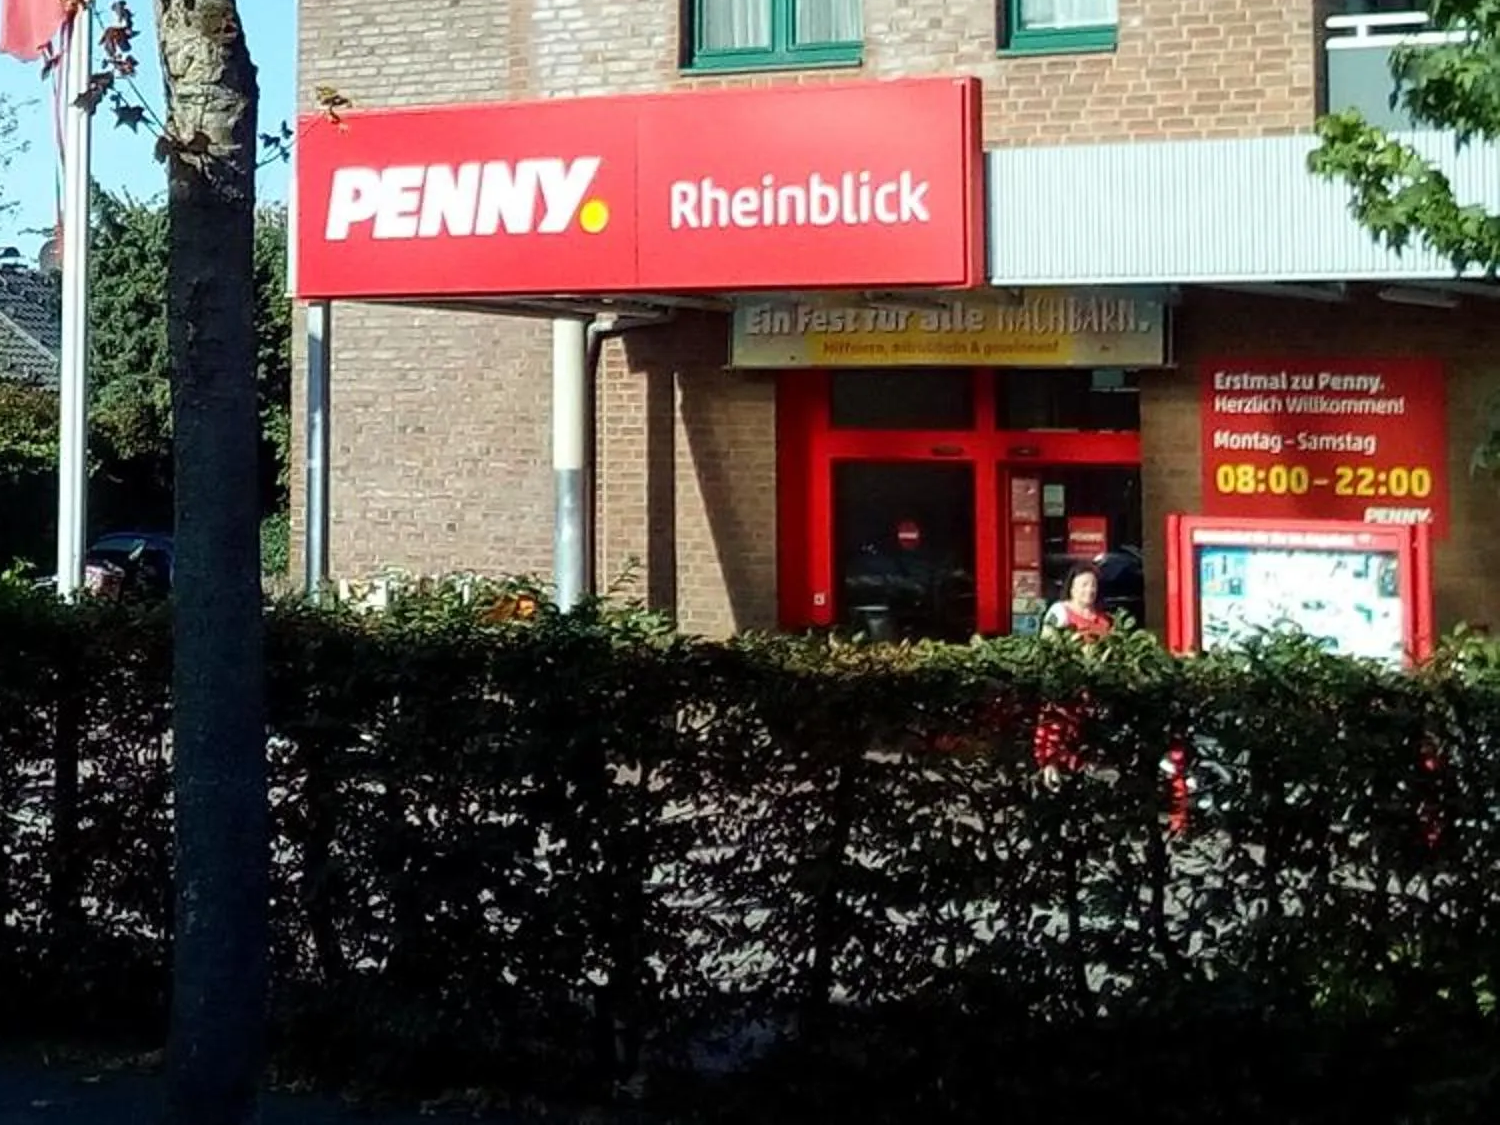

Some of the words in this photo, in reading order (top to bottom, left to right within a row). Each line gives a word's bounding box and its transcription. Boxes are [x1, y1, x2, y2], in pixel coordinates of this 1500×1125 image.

[670, 171, 930, 230] Rheinblick
[746, 303, 791, 335] Ein
[798, 305, 857, 335] Fest
[919, 301, 984, 332] alle
[1213, 372, 1287, 391] Erstmal
[1290, 375, 1315, 390] zu
[1317, 373, 1385, 395] Penny.
[1213, 395, 1283, 414] Herzlich
[1285, 395, 1405, 415] Willkommen!
[1213, 430, 1283, 454] Montag
[1297, 432, 1377, 456] Samstag
[1216, 465, 1309, 494] 08:00
[1335, 466, 1432, 497] 22:00
